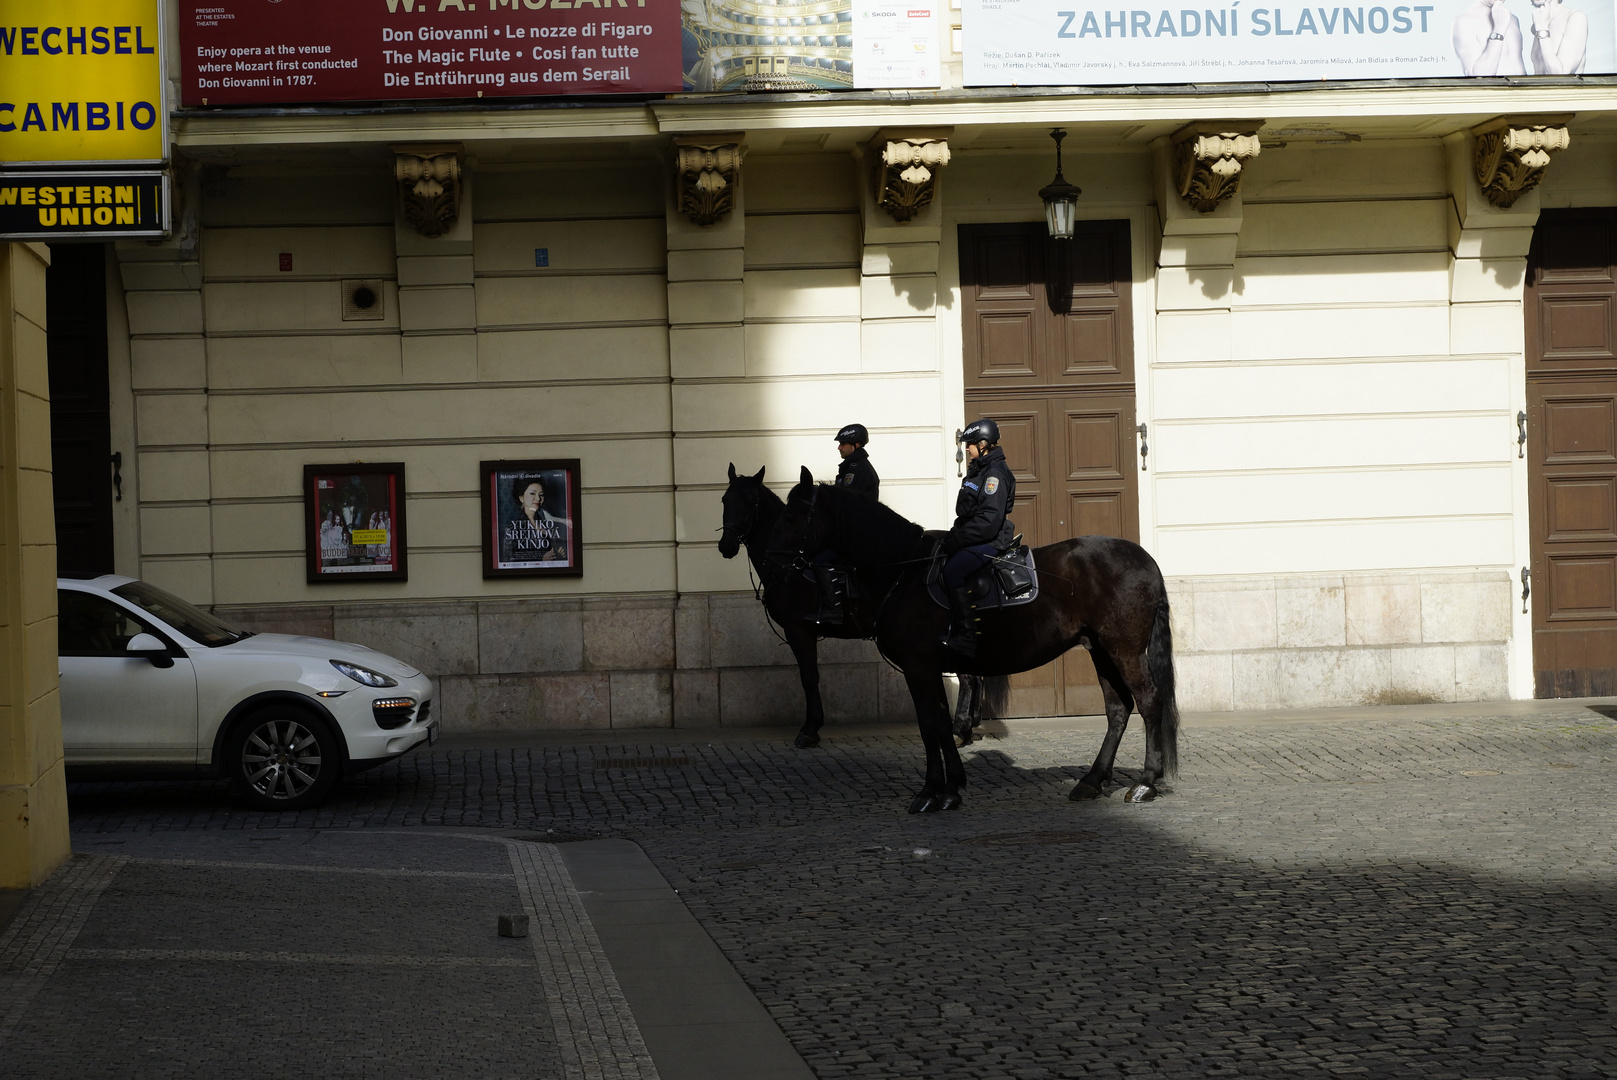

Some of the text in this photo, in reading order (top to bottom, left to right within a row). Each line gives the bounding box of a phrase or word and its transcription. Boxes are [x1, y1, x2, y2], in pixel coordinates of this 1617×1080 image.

[1057, 1, 1434, 38] ZAHRADNÍ SLAVNOST
[0, 26, 154, 55] WECHSEL
[383, 22, 653, 41] Don Giovanni Le nozze di Figaro
[197, 45, 331, 58] Enjoy opera at the venue
[383, 45, 639, 65] The Magic Flute Cosi fan tutte
[198, 58, 358, 72] where Mozart first conducted
[1142, 60, 1187, 68] Salzmannová,
[199, 75, 316, 88] Don Giovanni in 1787.
[384, 67, 631, 87] Die Entführung aus dem Serail
[0, 101, 156, 132] CAMBIO
[0, 185, 134, 206] WESTERN
[38, 206, 134, 226] UNION
[506, 527, 560, 540] ŠREJMOVÁ
[511, 520, 554, 530] YUKIKO
[517, 539, 549, 549] KINJO
